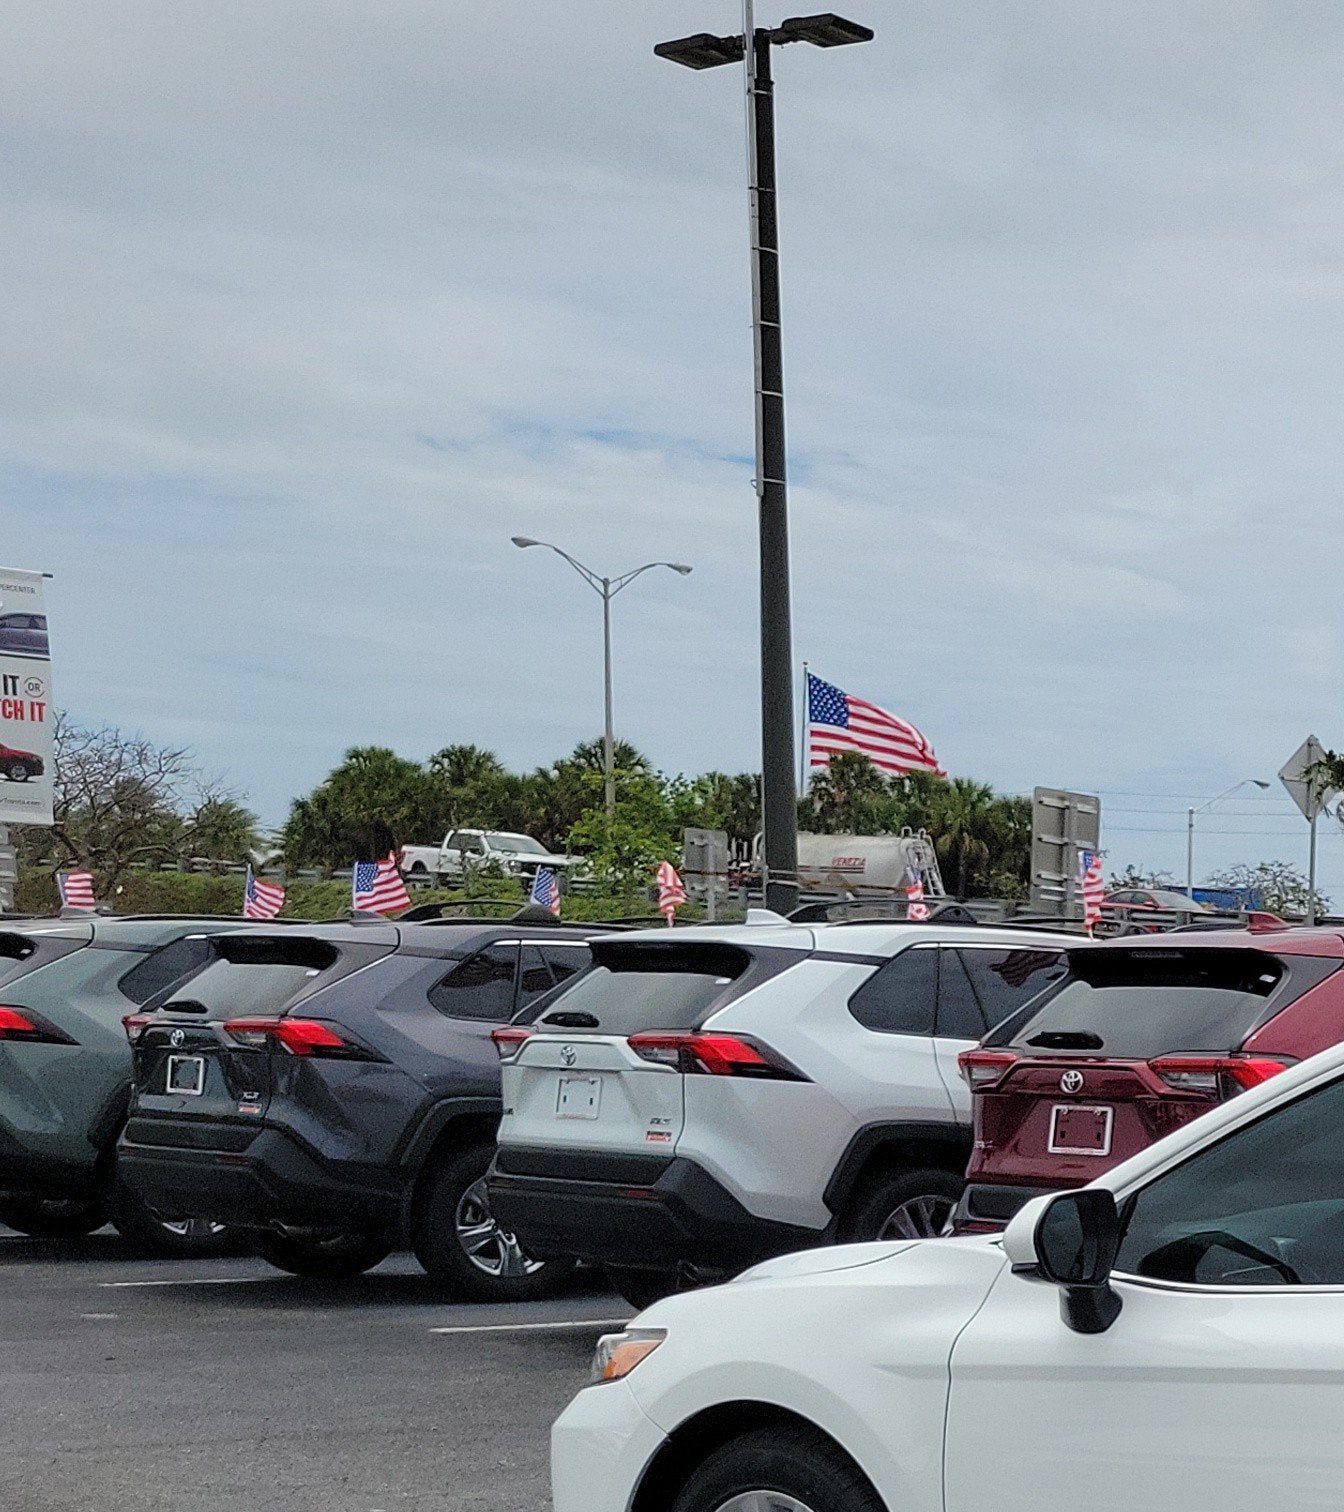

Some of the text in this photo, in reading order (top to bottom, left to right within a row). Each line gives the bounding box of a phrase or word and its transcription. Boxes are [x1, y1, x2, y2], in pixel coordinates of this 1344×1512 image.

[2, 673, 41, 696] IT OR
[30, 701, 46, 723] IT
